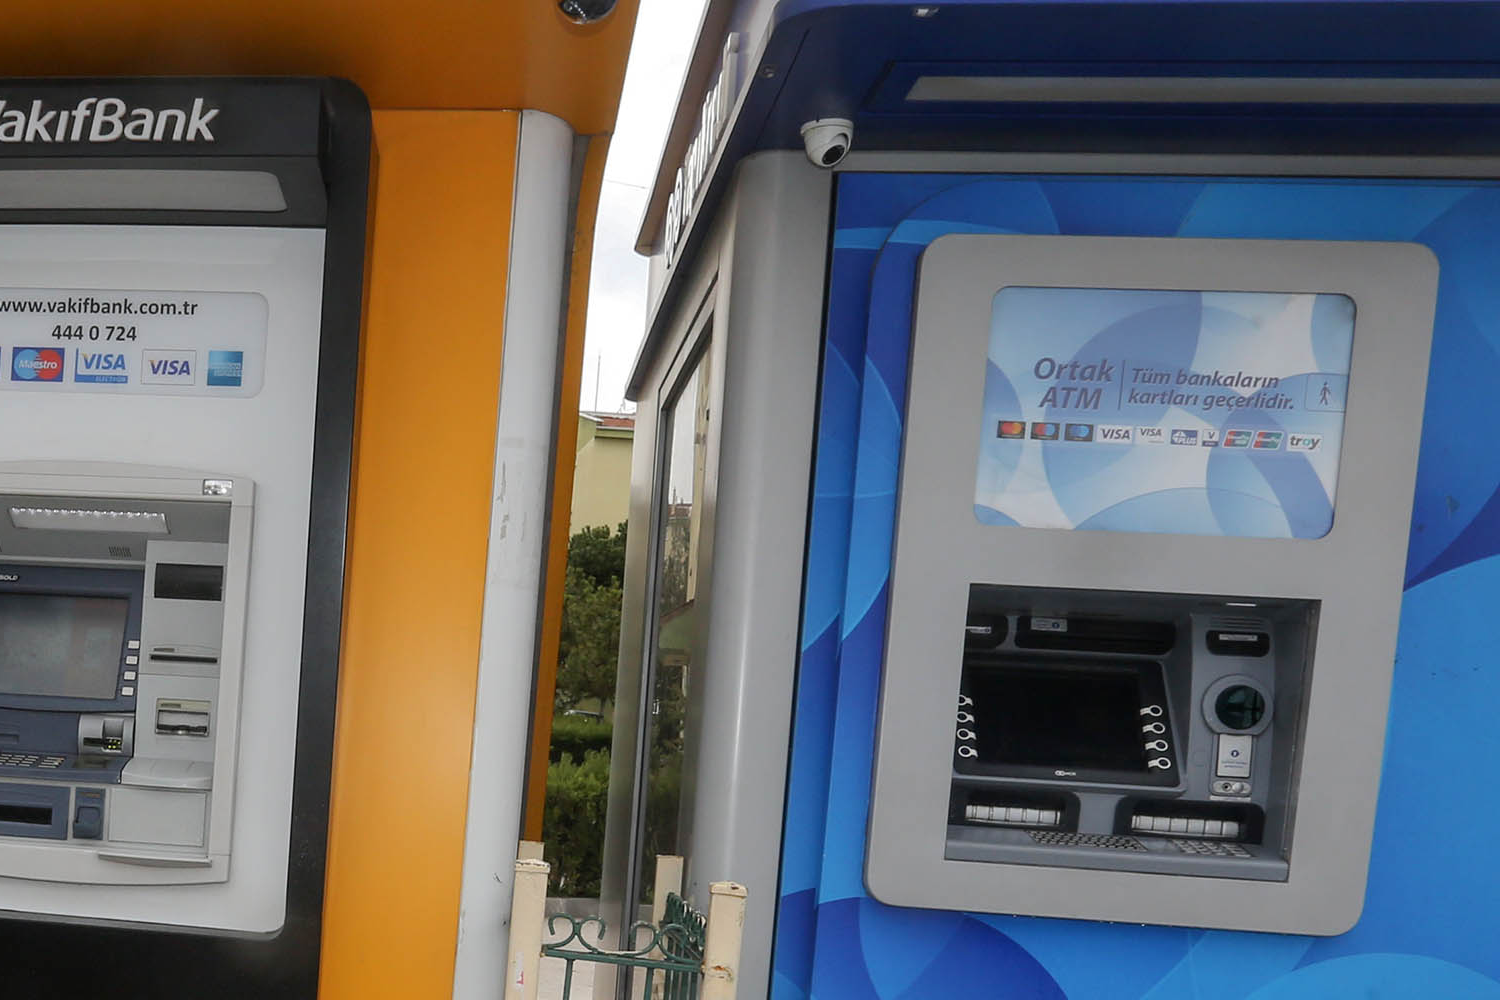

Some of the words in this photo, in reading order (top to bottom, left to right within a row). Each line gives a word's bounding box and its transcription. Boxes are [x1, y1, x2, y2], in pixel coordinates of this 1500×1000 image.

[51, 325, 84, 341] 444
[88, 326, 100, 341] 0
[105, 326, 138, 342] 724
[18, 359, 58, 369] Maestro
[82, 352, 127, 371] VISA
[149, 359, 191, 376] VISA
[1033, 357, 1115, 383] Ortak
[1131, 367, 1171, 385] Tüm
[1175, 369, 1280, 389] bankaların
[1038, 385, 1103, 410] ATM
[1127, 388, 1199, 407] kartları
[1201, 391, 1296, 413] geçerlidir.
[1101, 428, 1131, 440] VISA
[1140, 428, 1162, 437] VISA
[1289, 435, 1321, 450] troy
